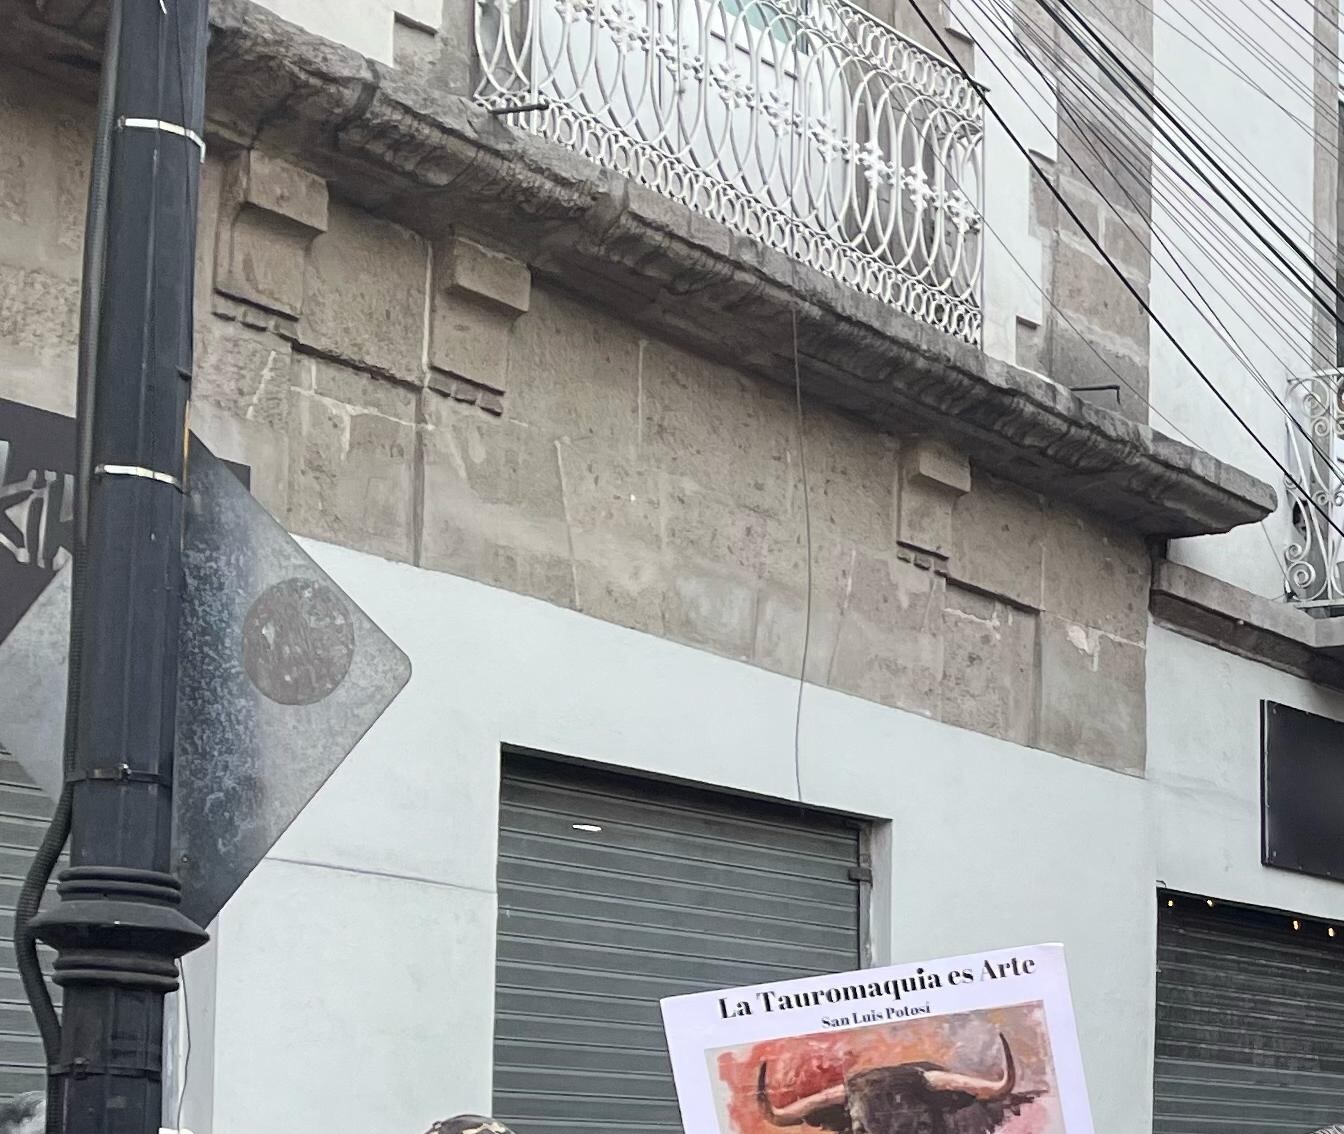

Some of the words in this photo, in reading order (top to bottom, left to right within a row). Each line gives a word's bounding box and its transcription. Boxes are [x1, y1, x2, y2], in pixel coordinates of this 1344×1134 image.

[717, 996, 753, 1020] La
[756, 967, 943, 1013] Tauromaquia
[947, 967, 974, 986] es
[979, 957, 1037, 982] Arte
[821, 1013, 851, 1029] San
[853, 1008, 883, 1025] Luis
